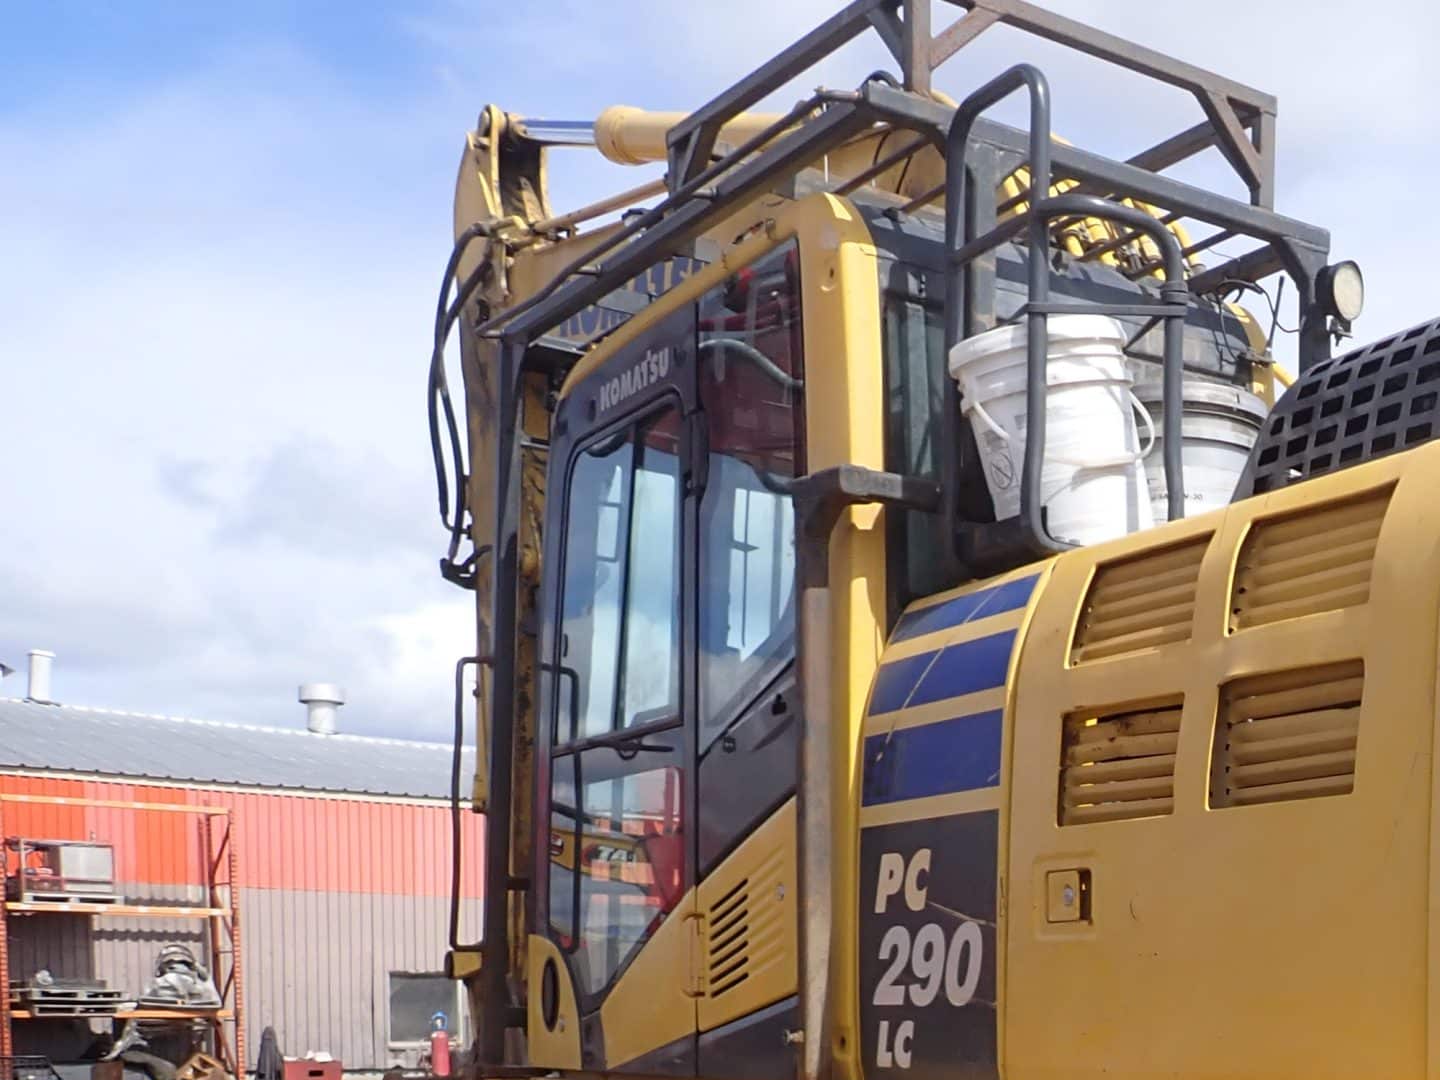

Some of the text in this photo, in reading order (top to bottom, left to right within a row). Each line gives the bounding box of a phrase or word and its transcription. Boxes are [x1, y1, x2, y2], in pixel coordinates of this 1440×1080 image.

[600, 347, 669, 411] KOMATSU
[874, 848, 932, 914] PC
[872, 920, 983, 1007] 290
[876, 1019, 915, 1069] LC
